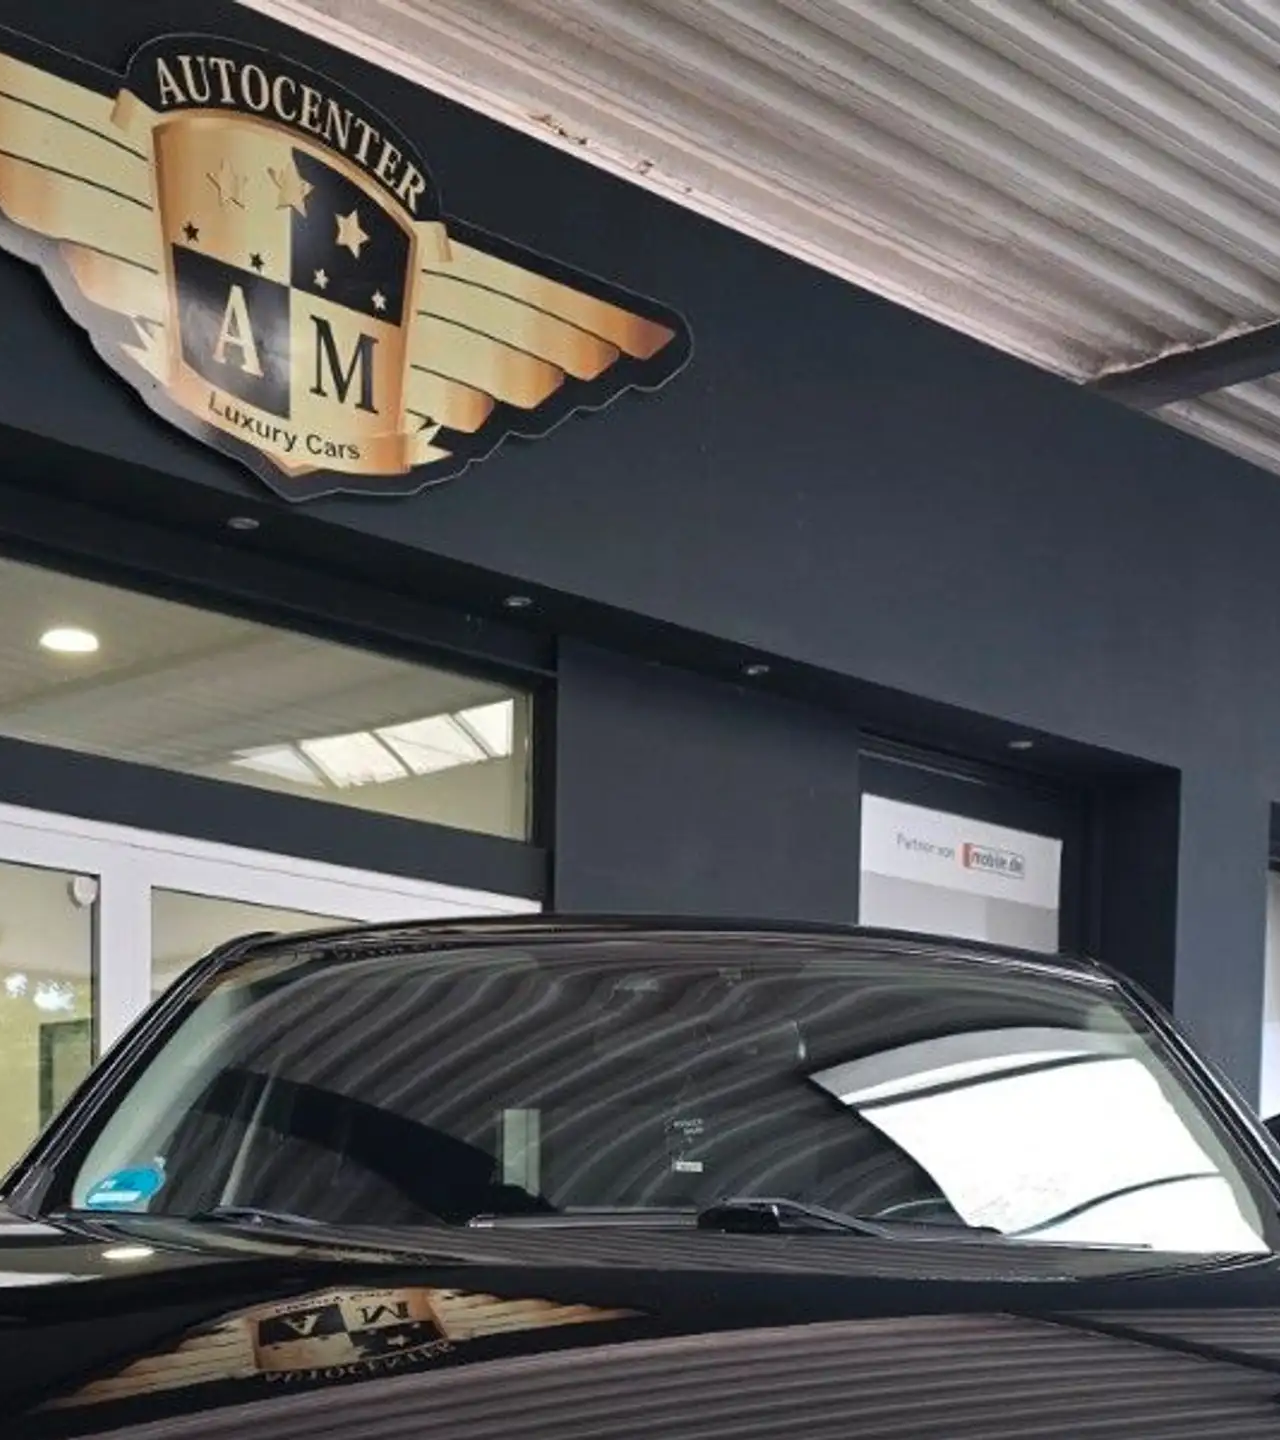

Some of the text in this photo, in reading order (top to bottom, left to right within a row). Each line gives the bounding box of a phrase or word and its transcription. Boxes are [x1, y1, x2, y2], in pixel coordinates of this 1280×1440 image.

[156, 55, 426, 212] AUTOCENTER
[212, 284, 379, 414] A M
[208, 391, 360, 460] Luxury Cars
